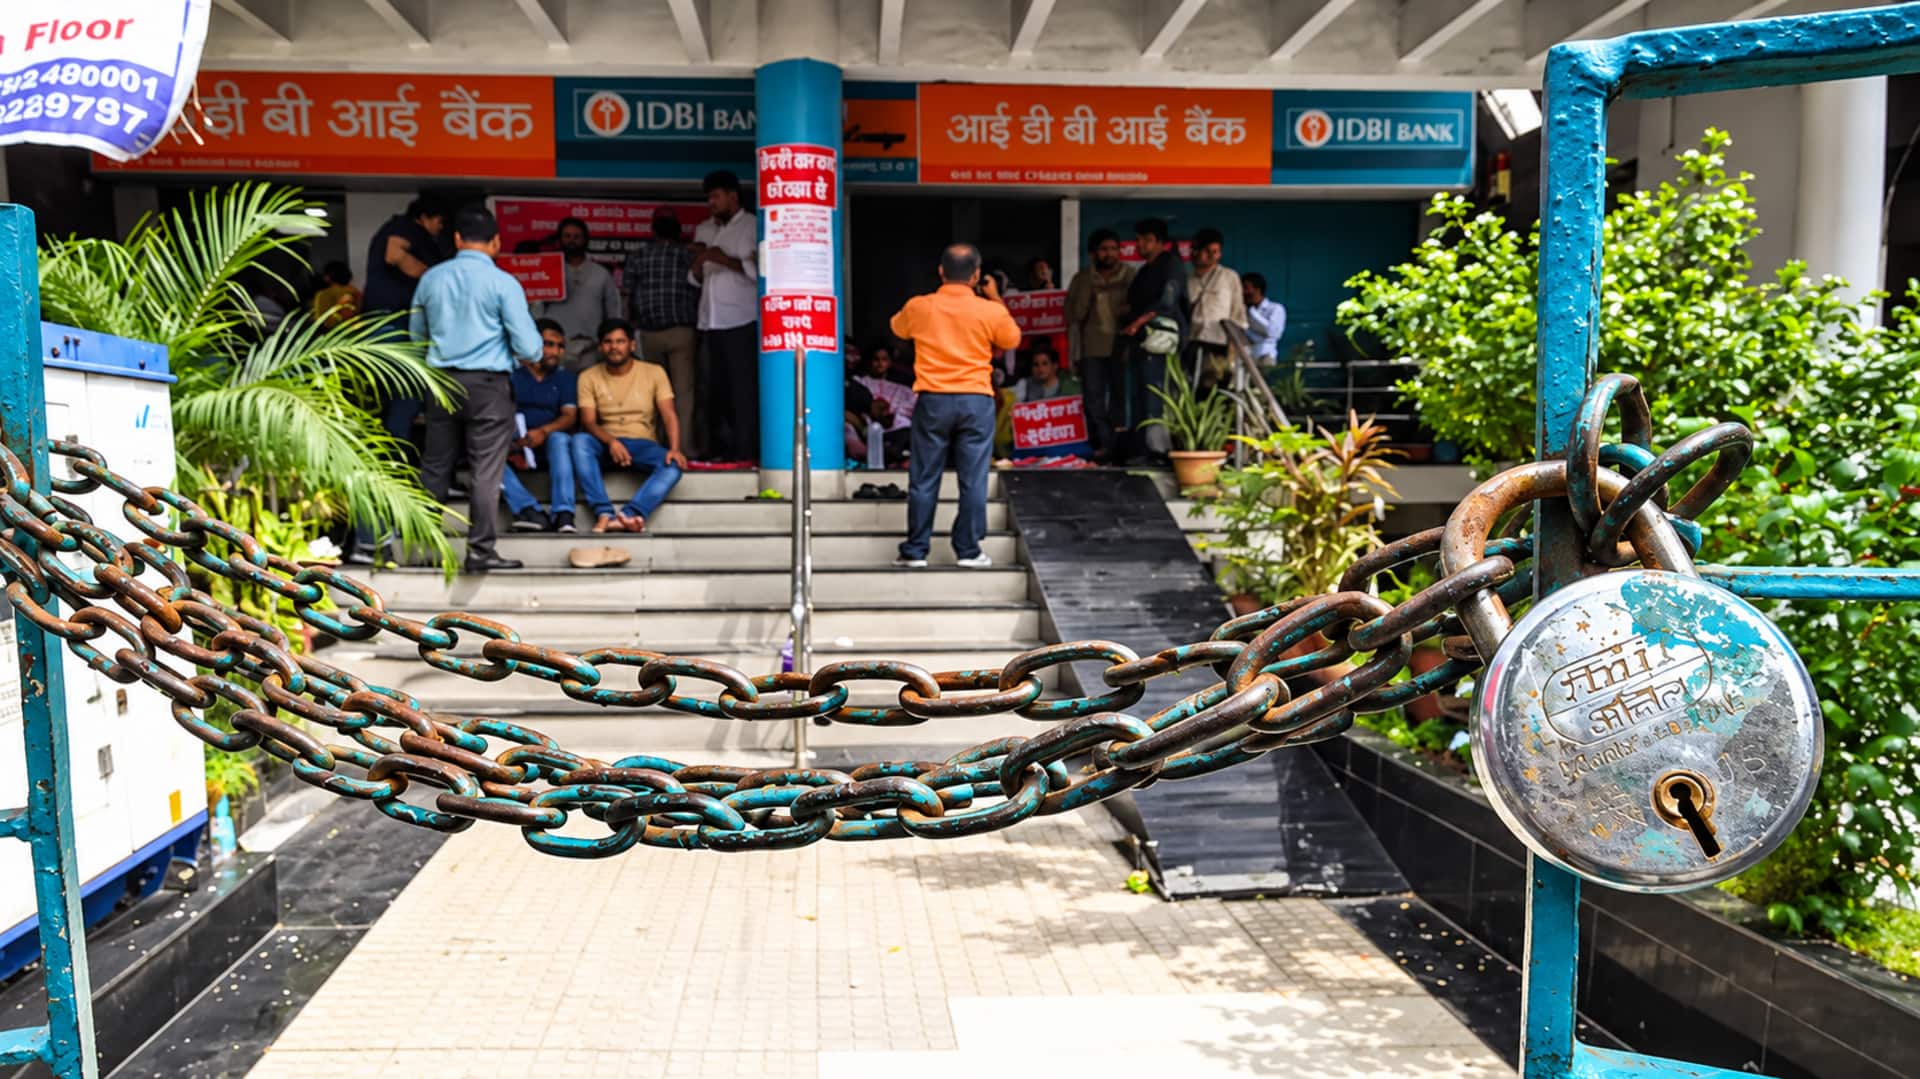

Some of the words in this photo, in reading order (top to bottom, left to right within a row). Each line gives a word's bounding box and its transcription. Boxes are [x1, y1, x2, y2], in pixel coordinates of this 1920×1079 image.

[24, 18, 135, 52] Floor
[262, 82, 314, 137] बी
[327, 83, 421, 147] आई
[440, 84, 534, 141] बैंक
[635, 101, 704, 131] IDBI
[946, 101, 1012, 149] आई
[1020, 104, 1054, 146] डी
[1062, 103, 1098, 146] बी
[1106, 104, 1169, 151] आई
[1183, 105, 1246, 147] बैंक
[1336, 118, 1391, 142] IDBI
[1396, 121, 1455, 143] BANK
